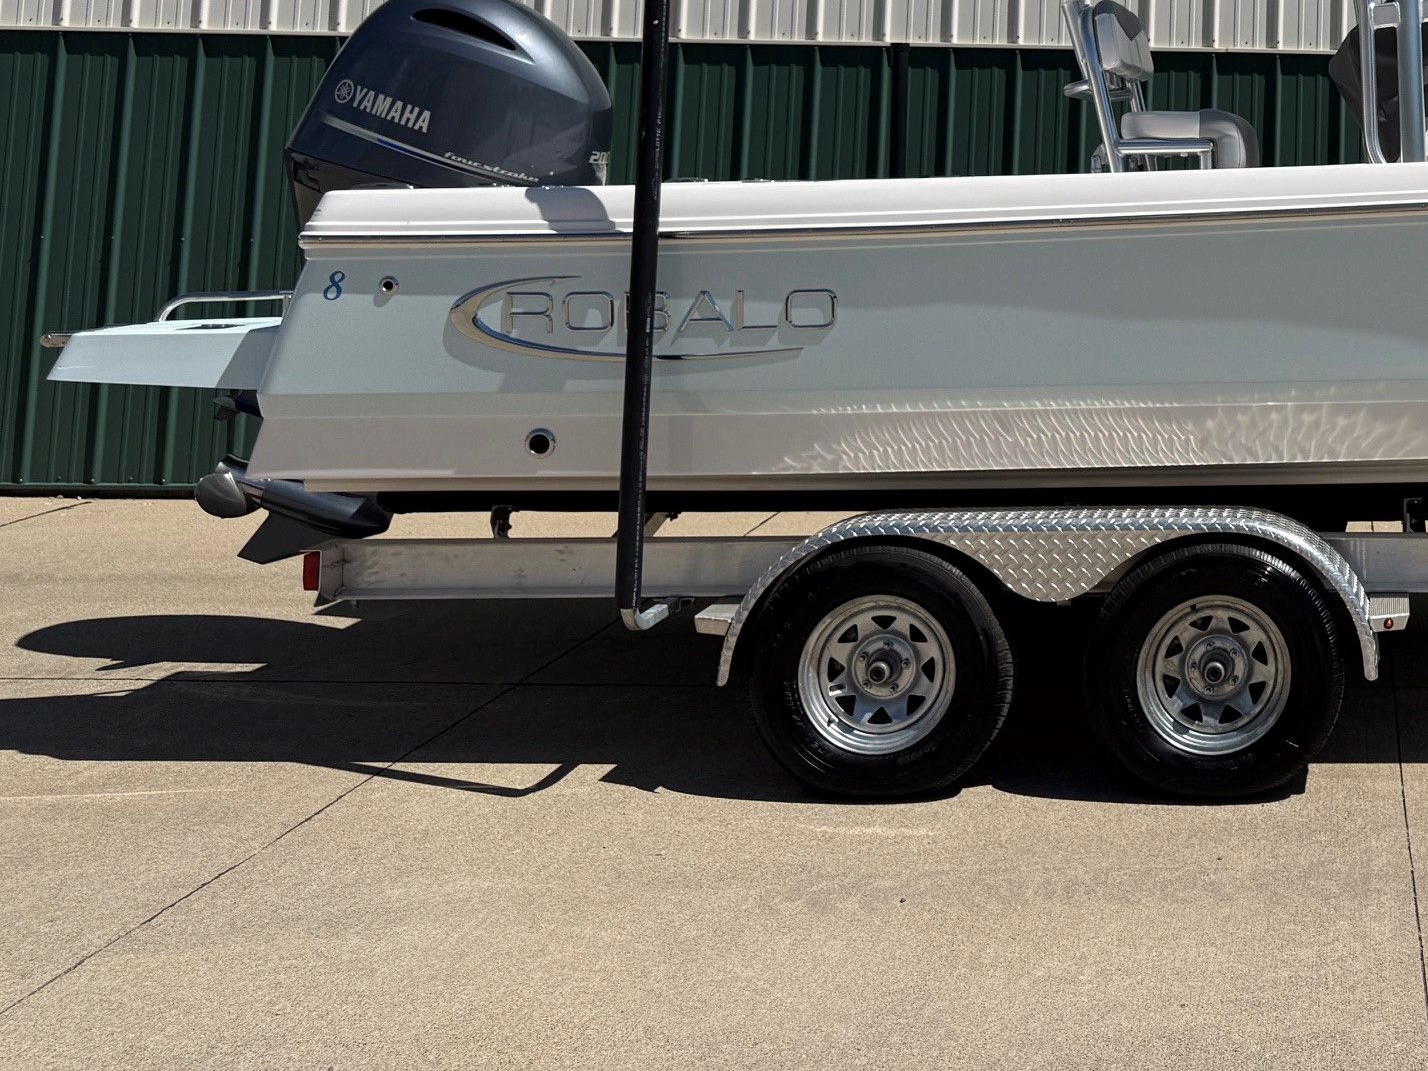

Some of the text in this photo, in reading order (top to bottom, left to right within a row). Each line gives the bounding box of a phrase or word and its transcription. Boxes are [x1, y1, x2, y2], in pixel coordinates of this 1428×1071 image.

[352, 85, 431, 134] YAMAHA
[322, 270, 346, 302] 8
[505, 287, 839, 334] ROBALO
